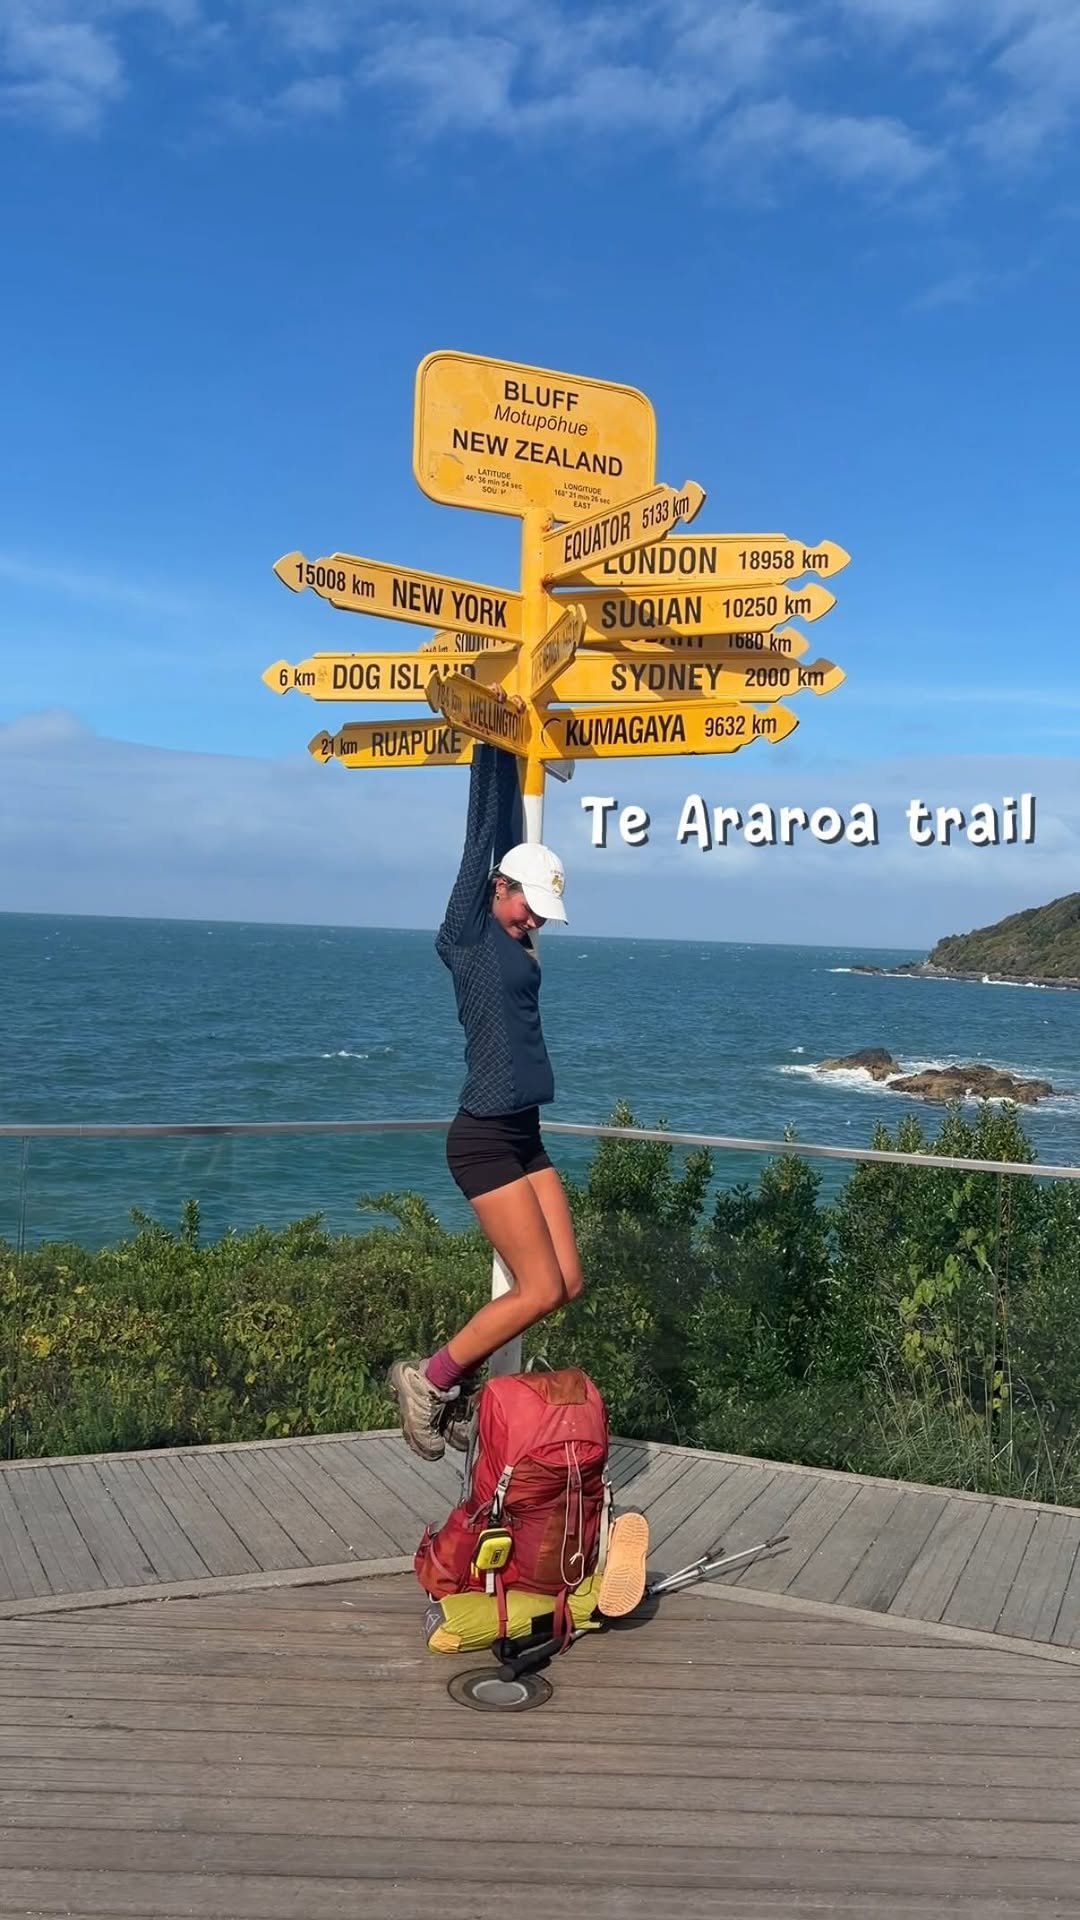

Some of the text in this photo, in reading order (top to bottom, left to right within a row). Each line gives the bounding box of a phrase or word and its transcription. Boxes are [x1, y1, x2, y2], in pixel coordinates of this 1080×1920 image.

[505, 380, 579, 411] BLUFF
[494, 404, 588, 436] Motupōhue
[453, 428, 623, 477] NEW ZEALAND
[478, 468, 511, 479] LATITUDE
[564, 482, 602, 495] LONGITUDE
[573, 501, 591, 509] EAST
[564, 495, 690, 563] EQUATOR 5133 km
[603, 546, 829, 575] LONDON 18958 km
[296, 562, 507, 628] 15008 km NEW YORK
[601, 595, 811, 629] SUQIAN 10250 km
[770, 633, 792, 652] km
[279, 669, 288, 687] 6
[294, 669, 315, 687] km
[332, 663, 381, 690] DOG
[611, 663, 824, 692] SYDNEY 2000 km
[469, 692, 524, 745] WELLINGTON
[565, 714, 776, 747] KUMAGAYA 9632 km
[321, 727, 462, 757] 21 km RUAPUKE
